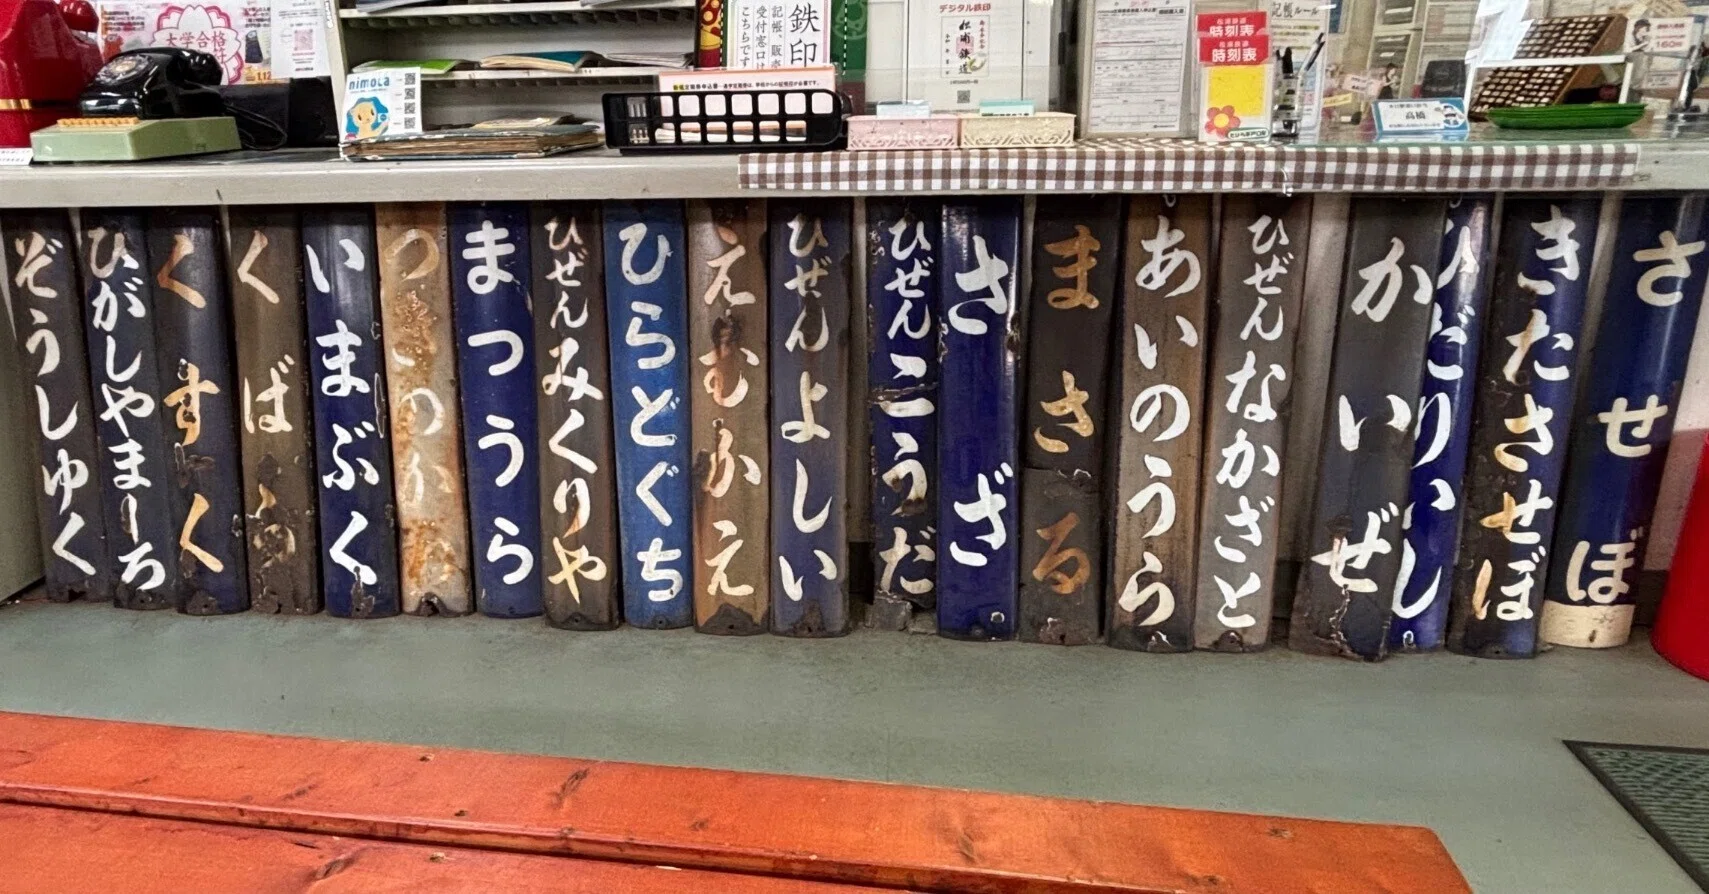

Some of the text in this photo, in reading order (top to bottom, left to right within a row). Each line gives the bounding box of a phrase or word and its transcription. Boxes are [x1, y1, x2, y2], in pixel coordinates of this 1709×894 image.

[166, 30, 227, 48] 大学合格
[348, 76, 390, 90] nimoca
[739, 6, 752, 69] こちらです
[755, 5, 768, 69] 受付窓口は
[788, 2, 821, 68] 鉄印
[939, 3, 991, 13] デジタル鉄印
[1209, 24, 1255, 37] 時刻表
[1211, 47, 1257, 63] 時刻表
[14, 230, 96, 576] ぞうしゅく
[157, 233, 225, 574] くすく
[305, 237, 380, 586] いまぶく
[384, 227, 457, 586] つのか
[461, 219, 535, 585] まつうら
[541, 216, 608, 604] ひぜんみくりや
[618, 222, 686, 602] ひらどぐち
[699, 226, 763, 597] えむかえ
[779, 214, 838, 602] ひぜんよしい
[878, 218, 937, 595] ひぜんこうだ
[947, 234, 1014, 567] さざ
[1031, 224, 1101, 595] まさる
[1118, 215, 1202, 627] あいのうら
[1213, 214, 1295, 629] ひぜんなかざと
[1310, 236, 1434, 594] かいぜ
[1472, 204, 1582, 621] きたさせぼ
[1565, 230, 1708, 604] させぼ
